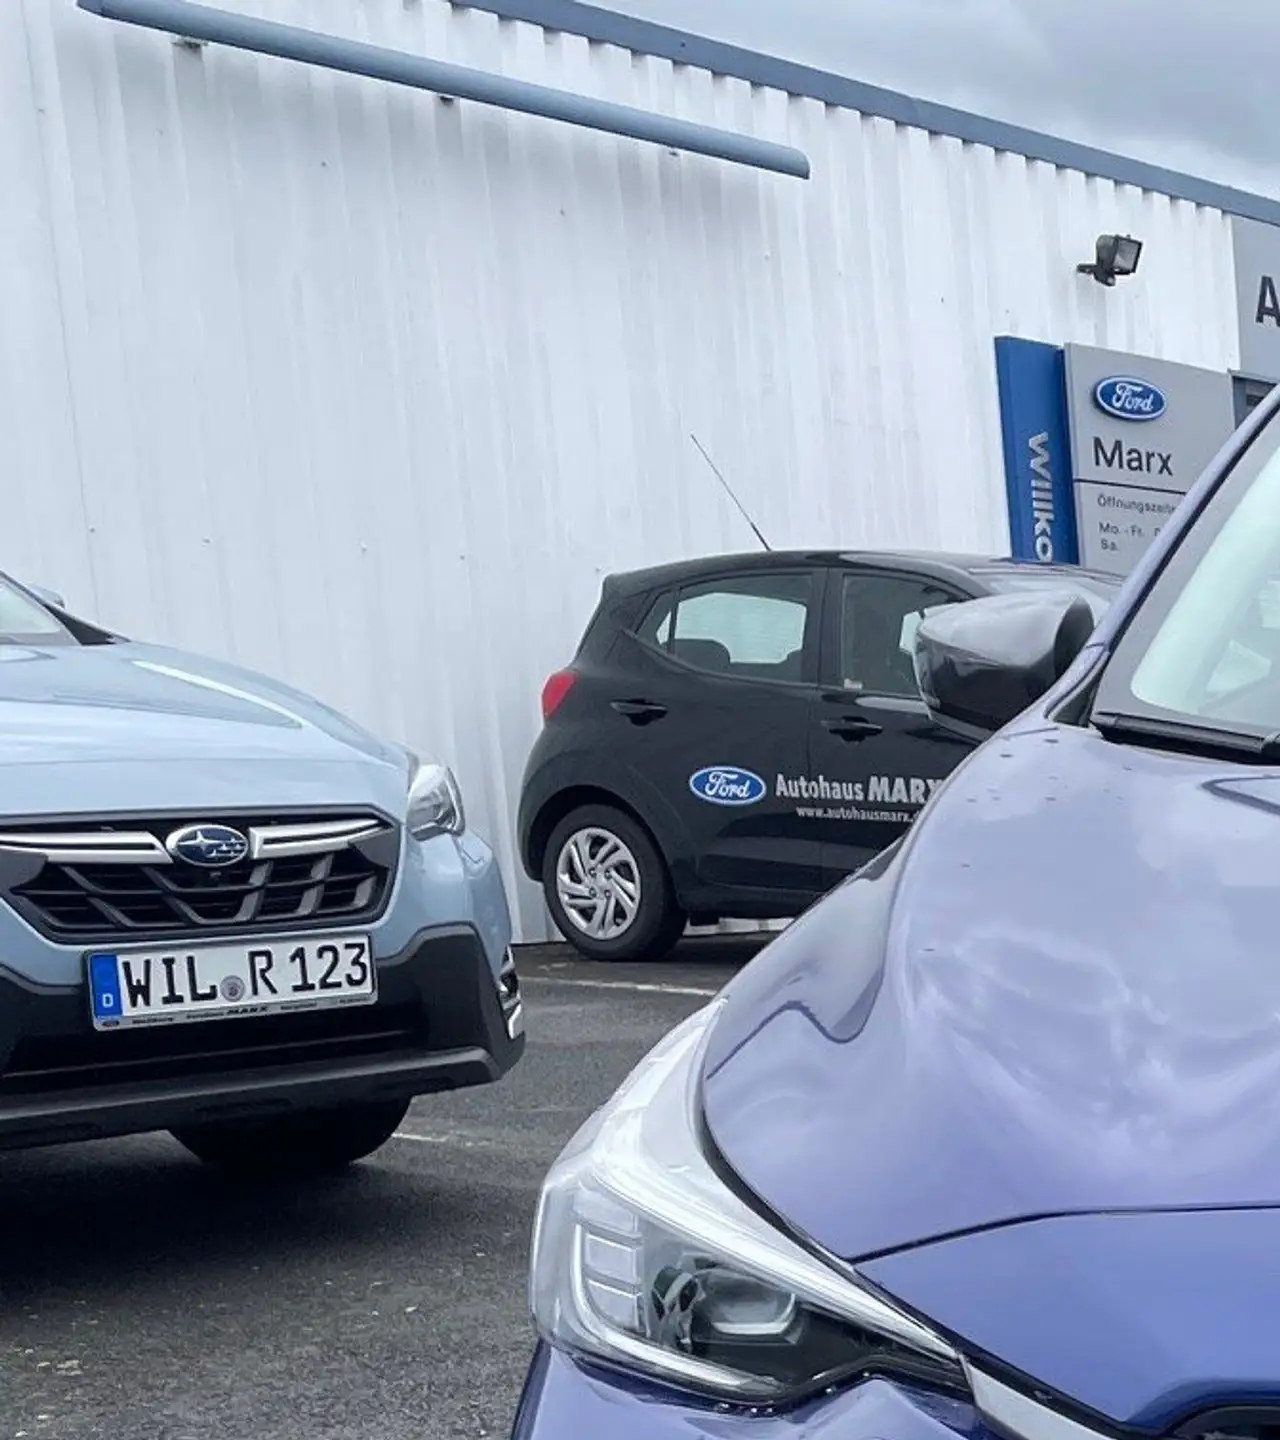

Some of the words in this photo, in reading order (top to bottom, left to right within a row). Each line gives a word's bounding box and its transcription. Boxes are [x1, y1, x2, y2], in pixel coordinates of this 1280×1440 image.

[1112, 382, 1155, 411] Ford
[1093, 437, 1174, 476] Marx
[705, 771, 751, 799] Ford
[775, 774, 864, 800] Autohaus
[122, 955, 218, 1008] WIL
[248, 949, 278, 996] R
[289, 942, 369, 992] 123
[102, 993, 113, 1007] D
